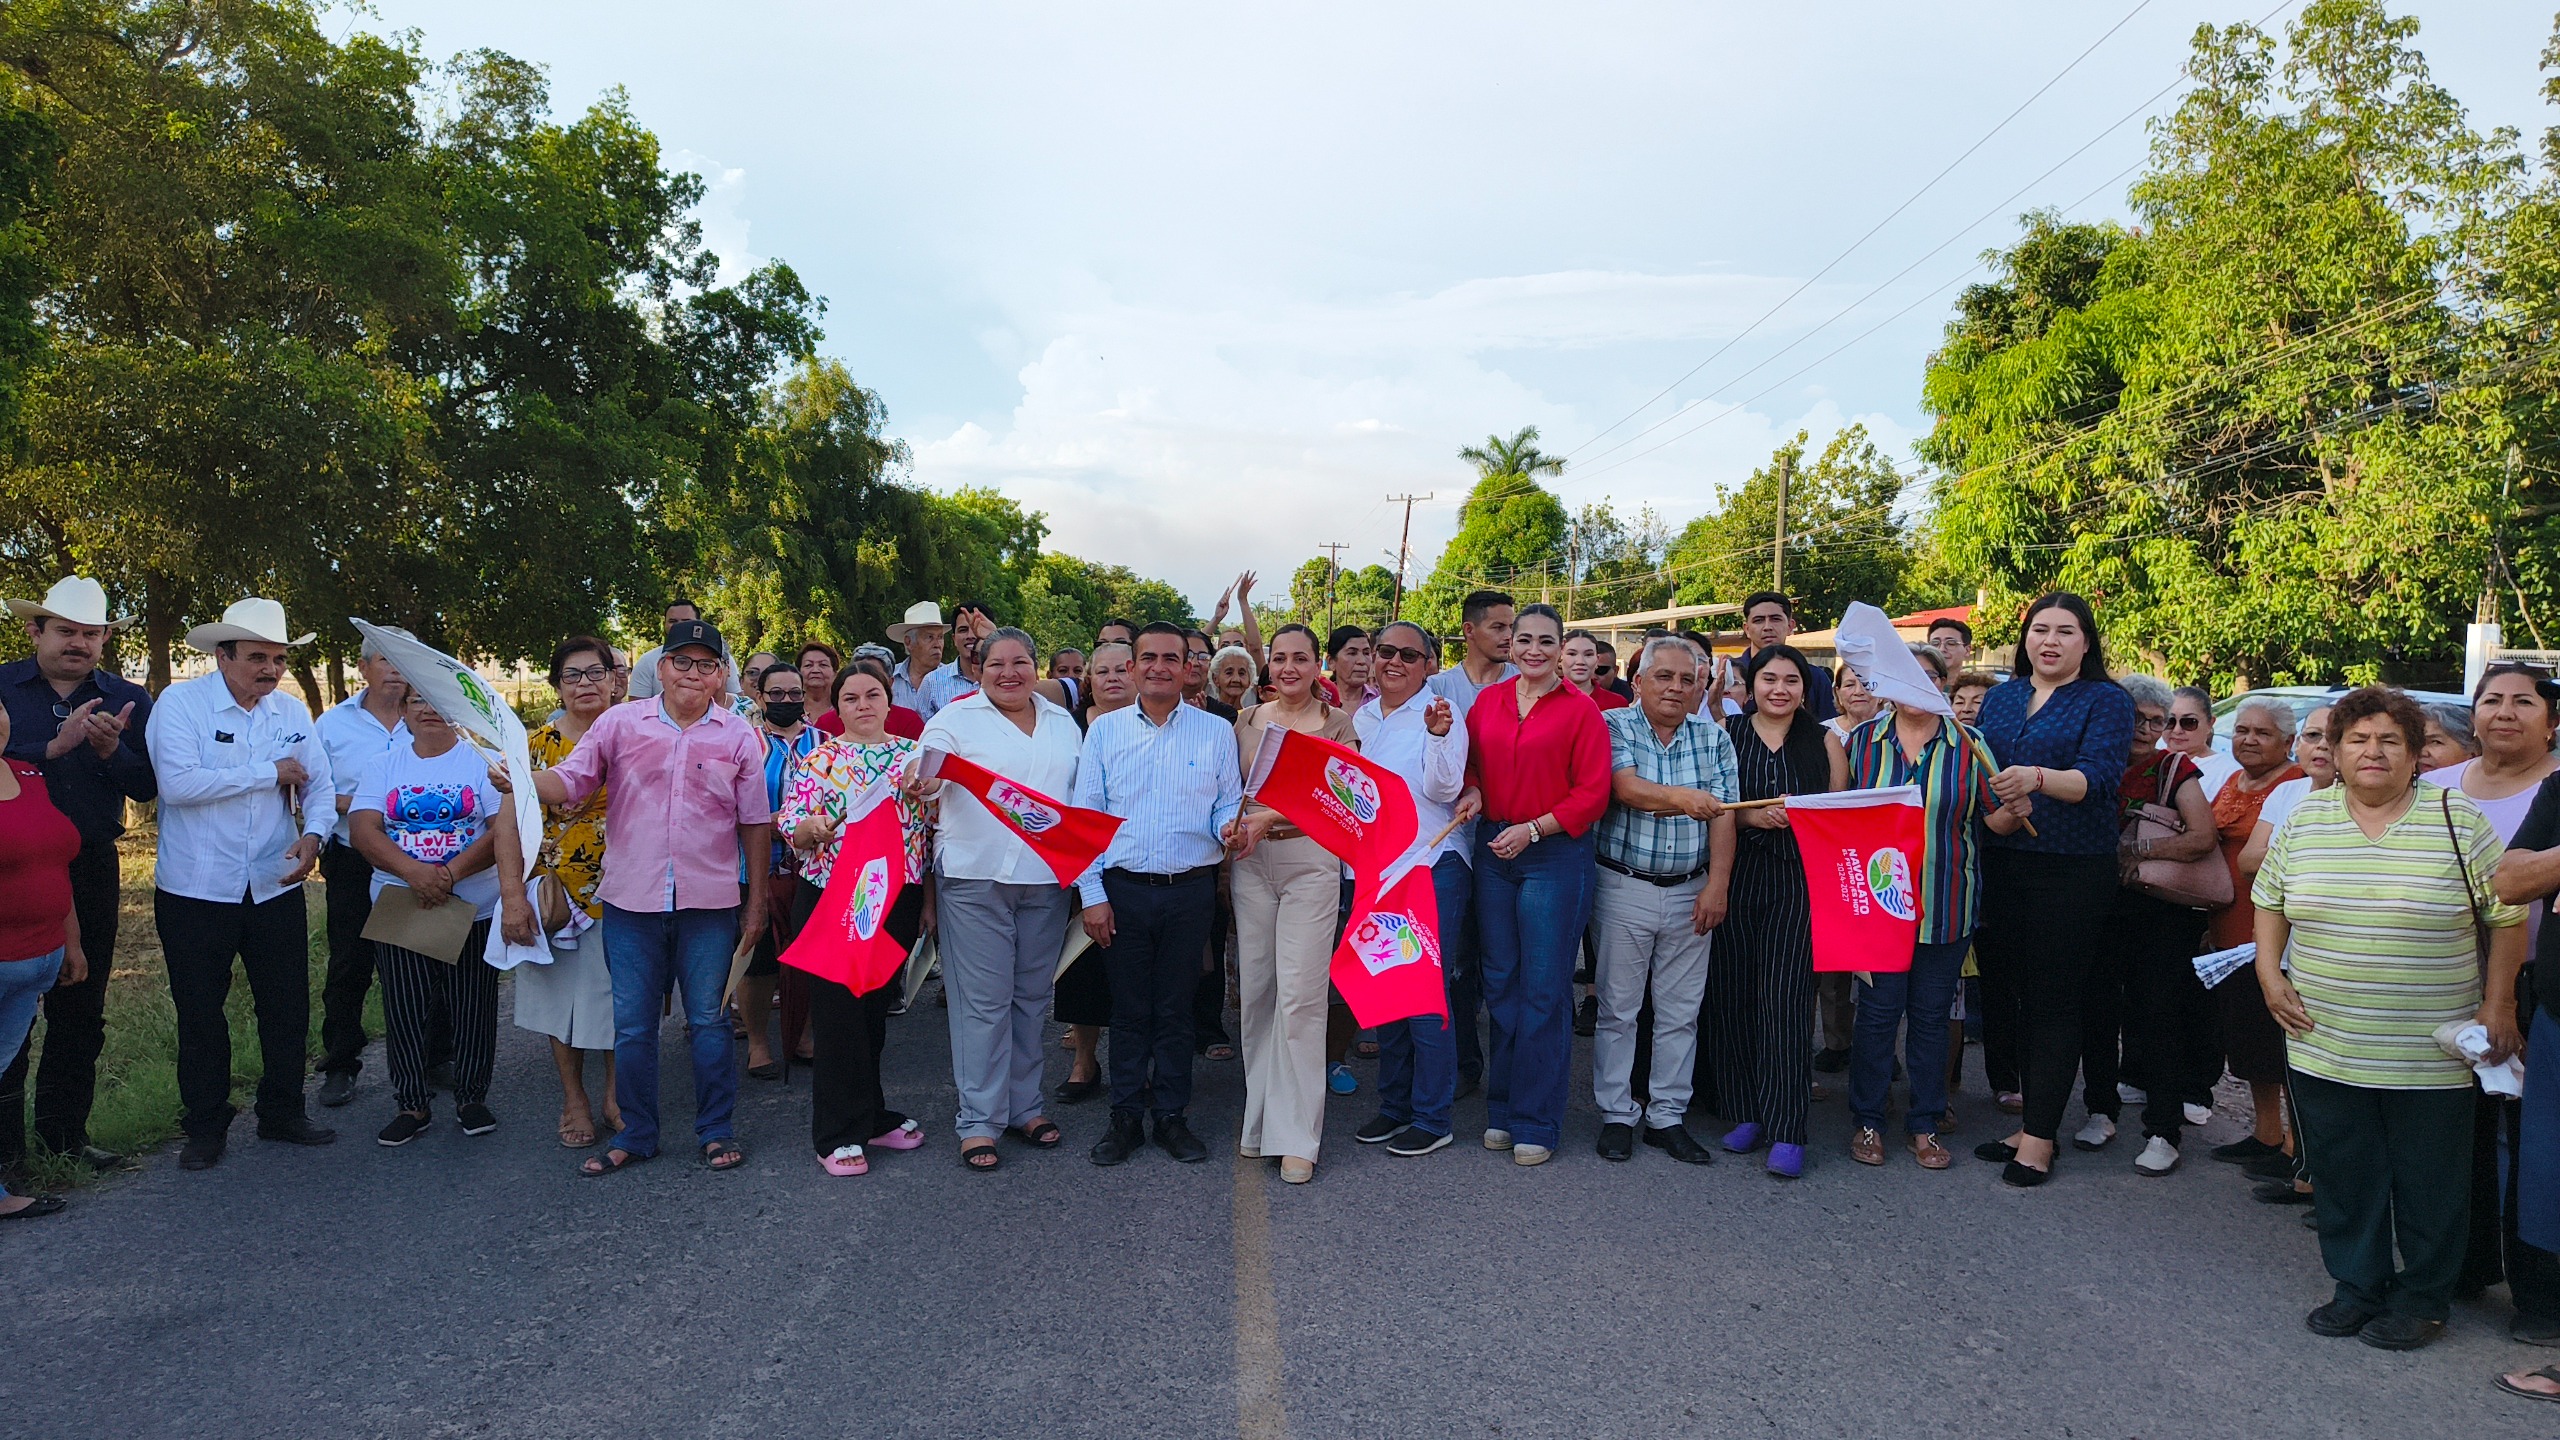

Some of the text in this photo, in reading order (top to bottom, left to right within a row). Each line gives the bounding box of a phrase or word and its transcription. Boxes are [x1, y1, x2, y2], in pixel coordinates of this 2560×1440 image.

[1313, 787, 1364, 837] NAVOLATO
[1320, 807, 1354, 834] 2024-2027
[403, 835, 408, 847] I
[421, 848, 444, 857] YOU
[1836, 862, 1850, 903] 2024-2027
[1845, 858, 1856, 885] FUTURO
[1847, 848, 1870, 915] NAVOLATO
